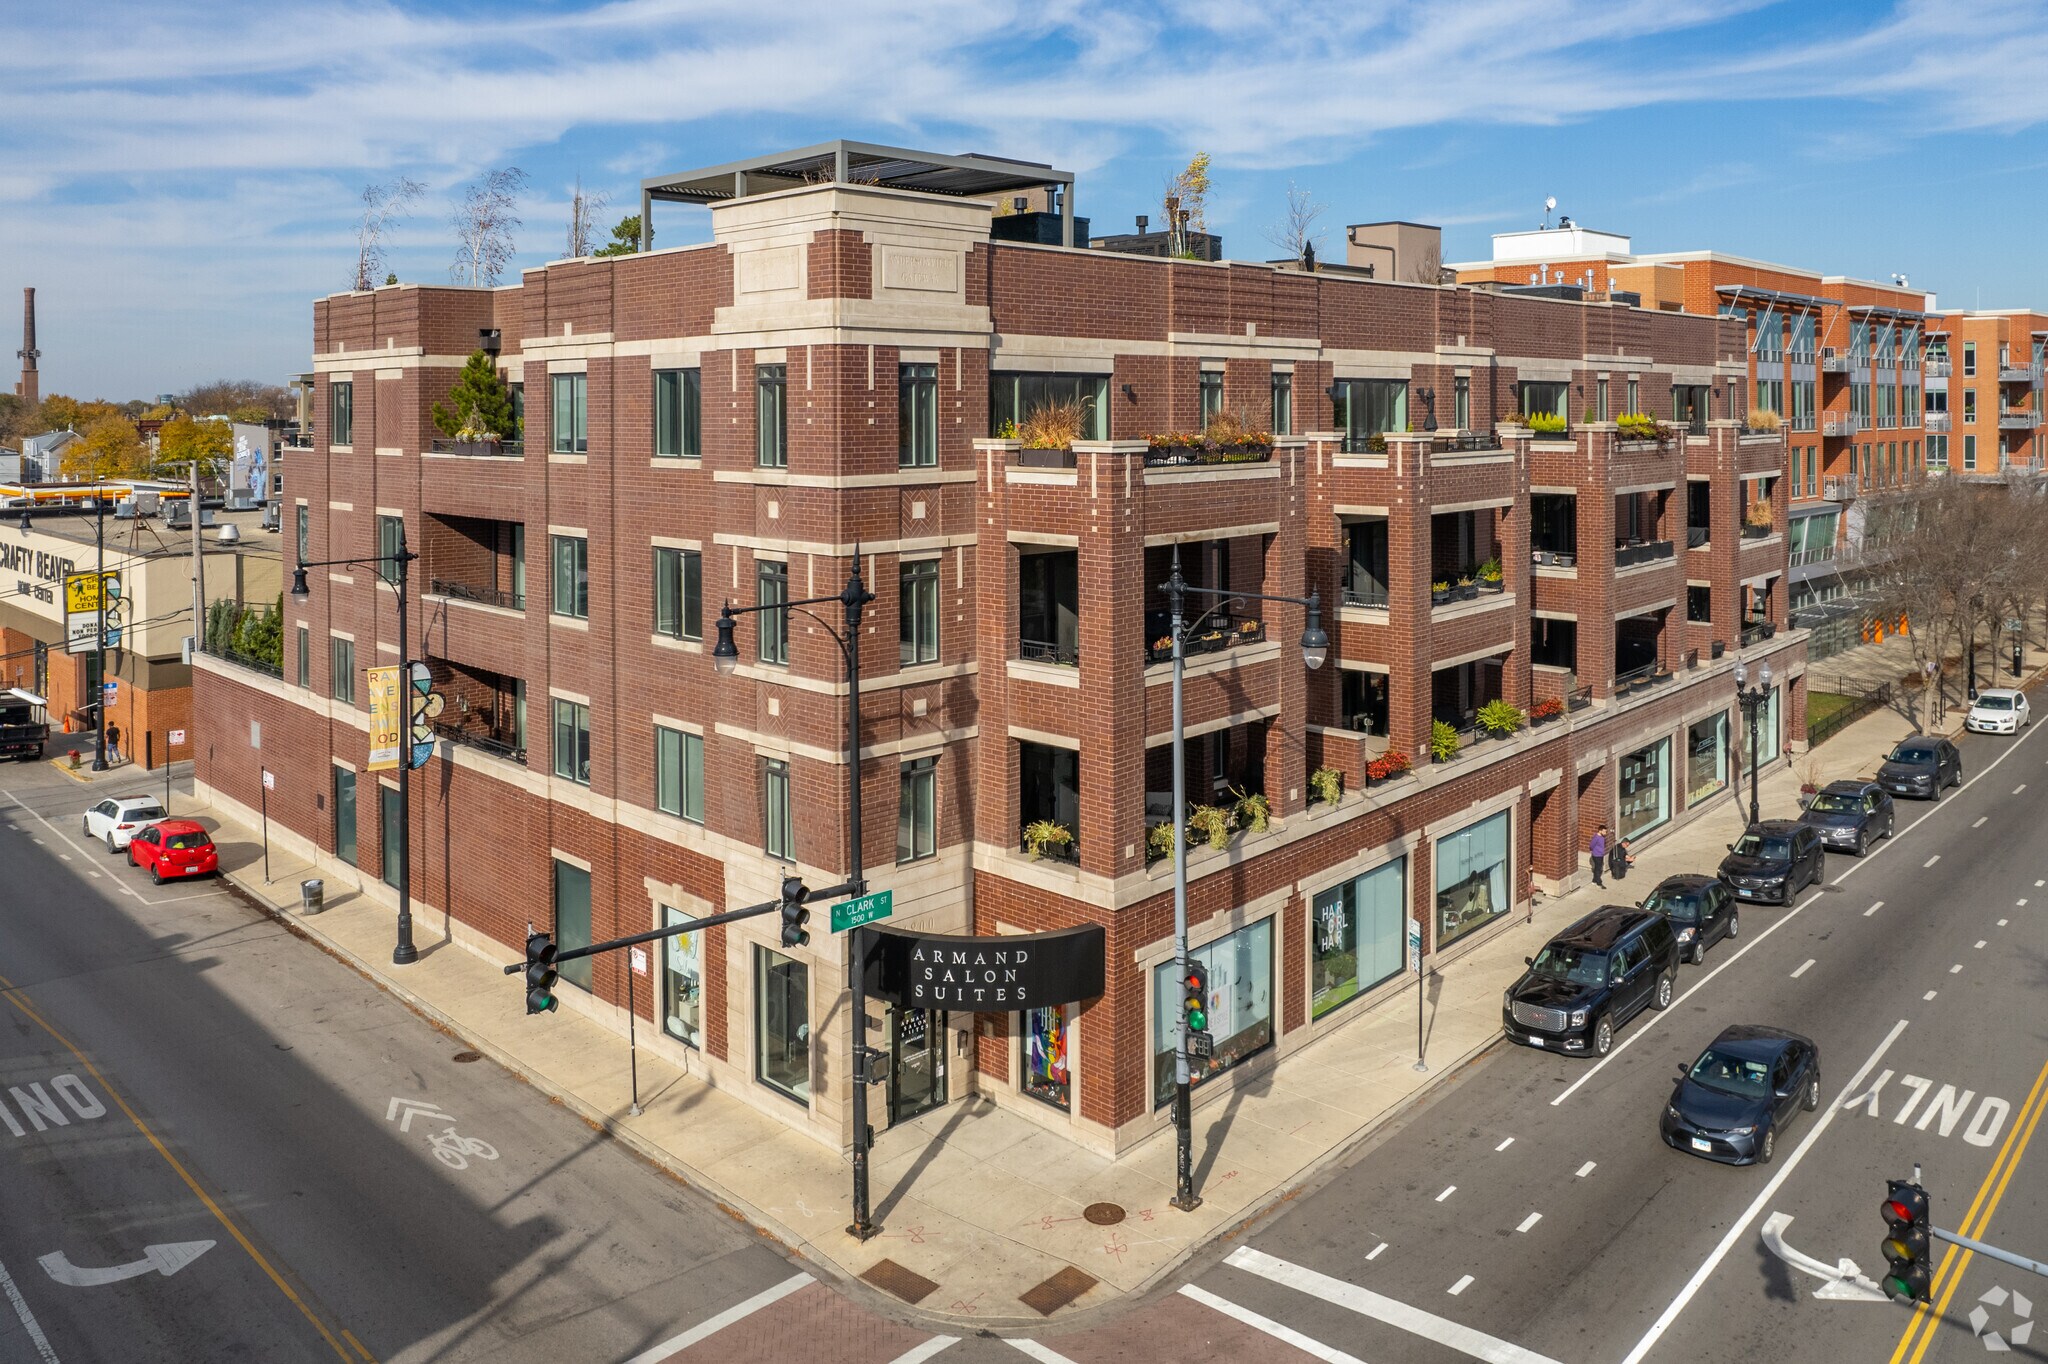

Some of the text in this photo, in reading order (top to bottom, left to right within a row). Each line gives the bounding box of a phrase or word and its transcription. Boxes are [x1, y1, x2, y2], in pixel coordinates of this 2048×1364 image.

[0, 541, 33, 576] CRAFTY
[846, 898, 874, 916] CLARK
[880, 896, 887, 904] ST
[851, 911, 873, 924] 1500 W
[914, 948, 1028, 965] ARMAND
[924, 967, 1017, 983] SALON
[915, 985, 1026, 1001] SUITES
[1843, 1068, 2011, 1147] ONLY
